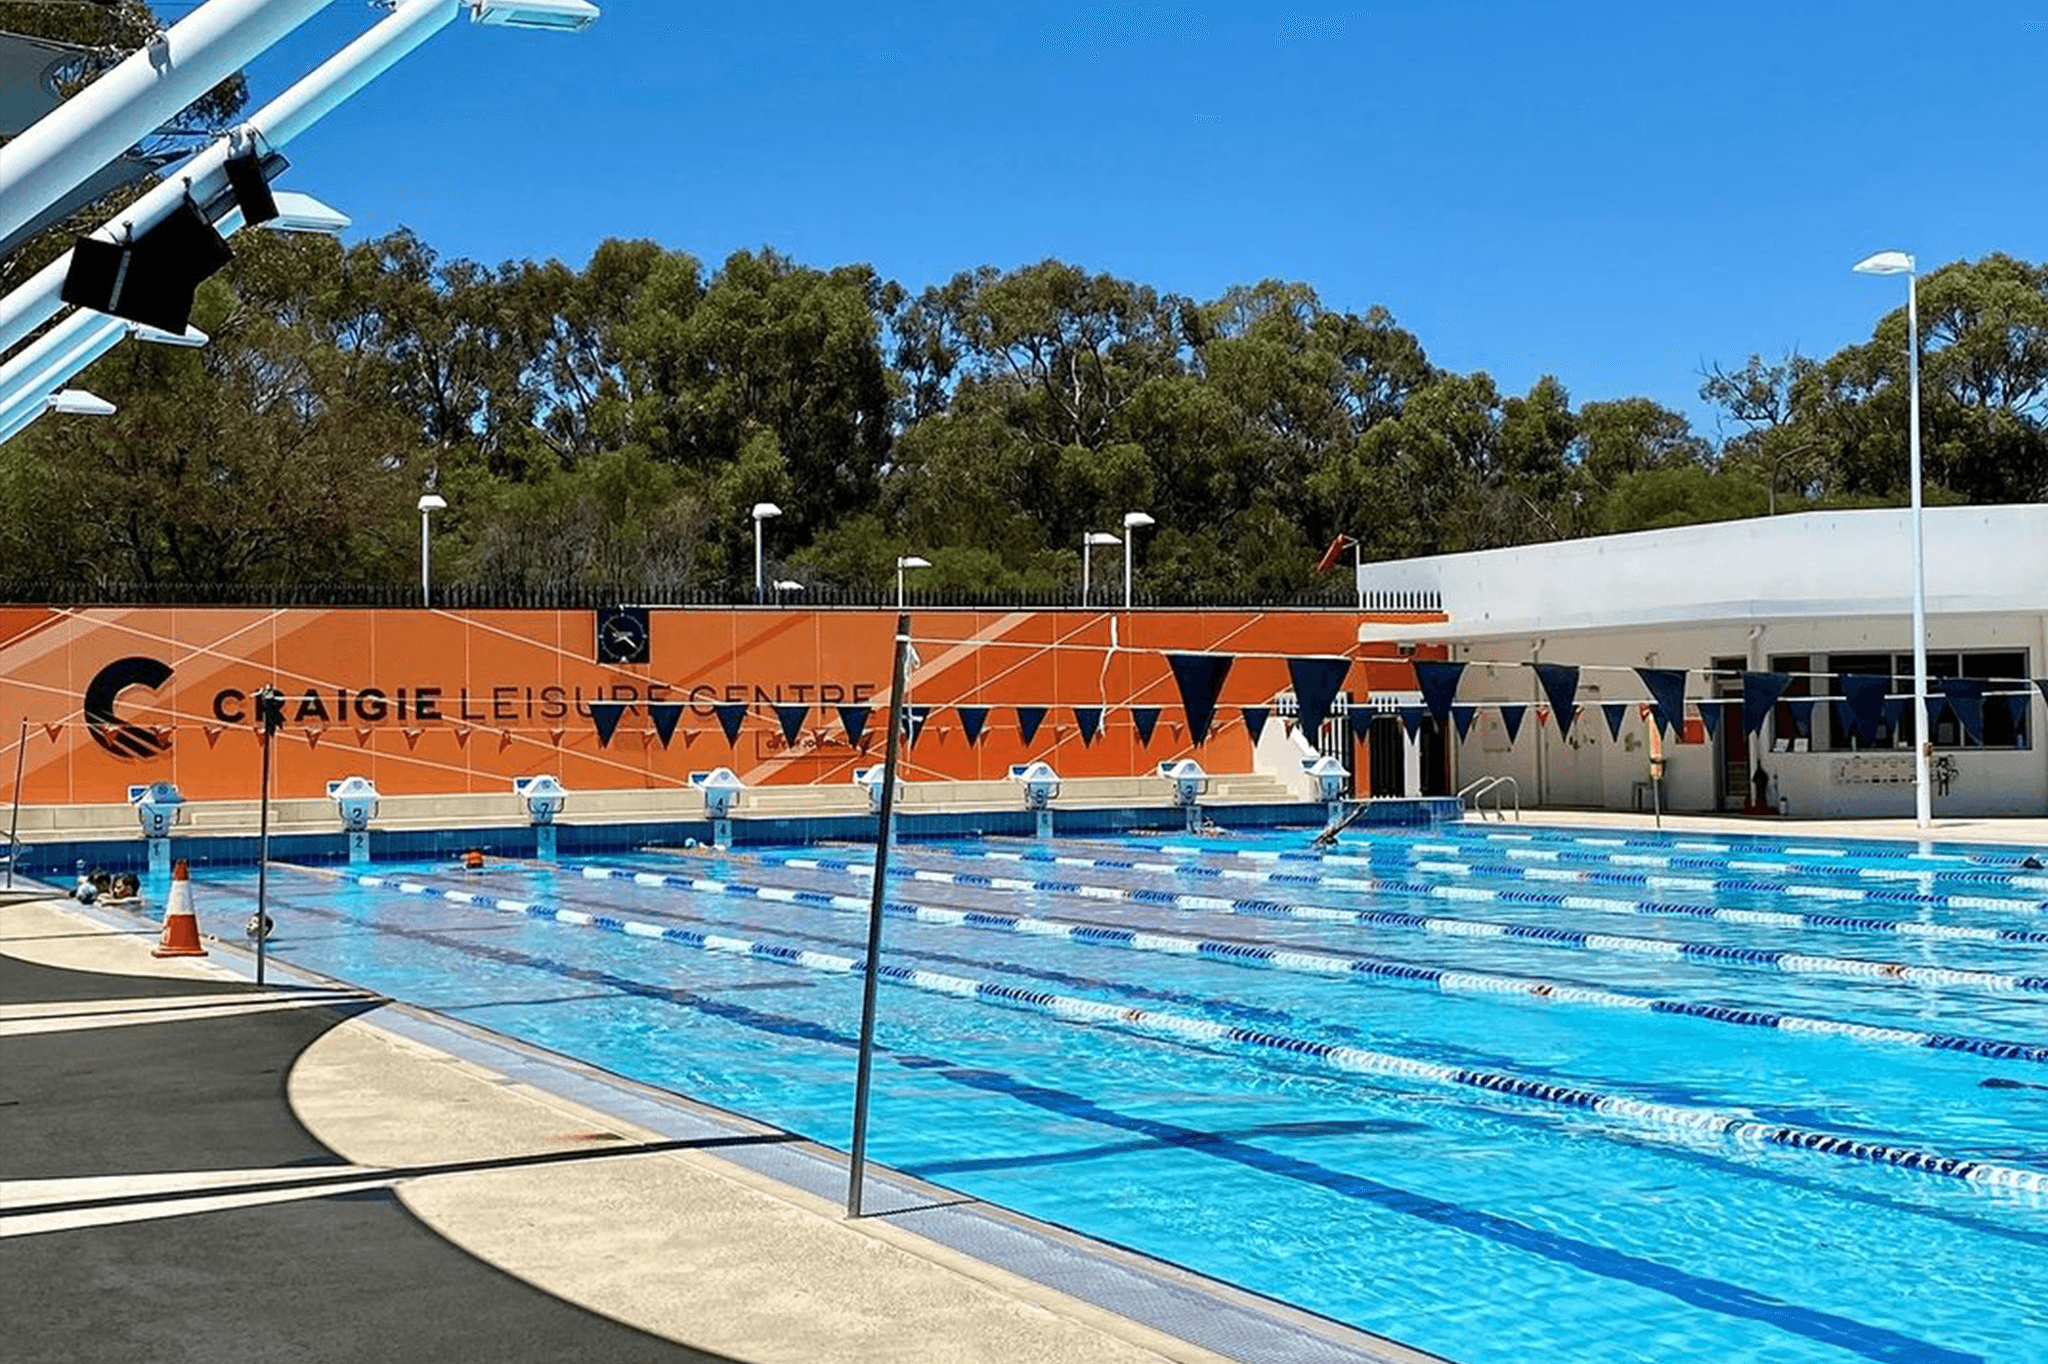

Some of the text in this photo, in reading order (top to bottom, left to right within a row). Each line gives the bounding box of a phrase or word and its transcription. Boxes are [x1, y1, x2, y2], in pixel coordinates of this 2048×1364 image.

[213, 687, 443, 722] CRAIGIE
[688, 683, 877, 717] CENTRE
[540, 802, 550, 820] 7
[355, 835, 364, 849] 2
